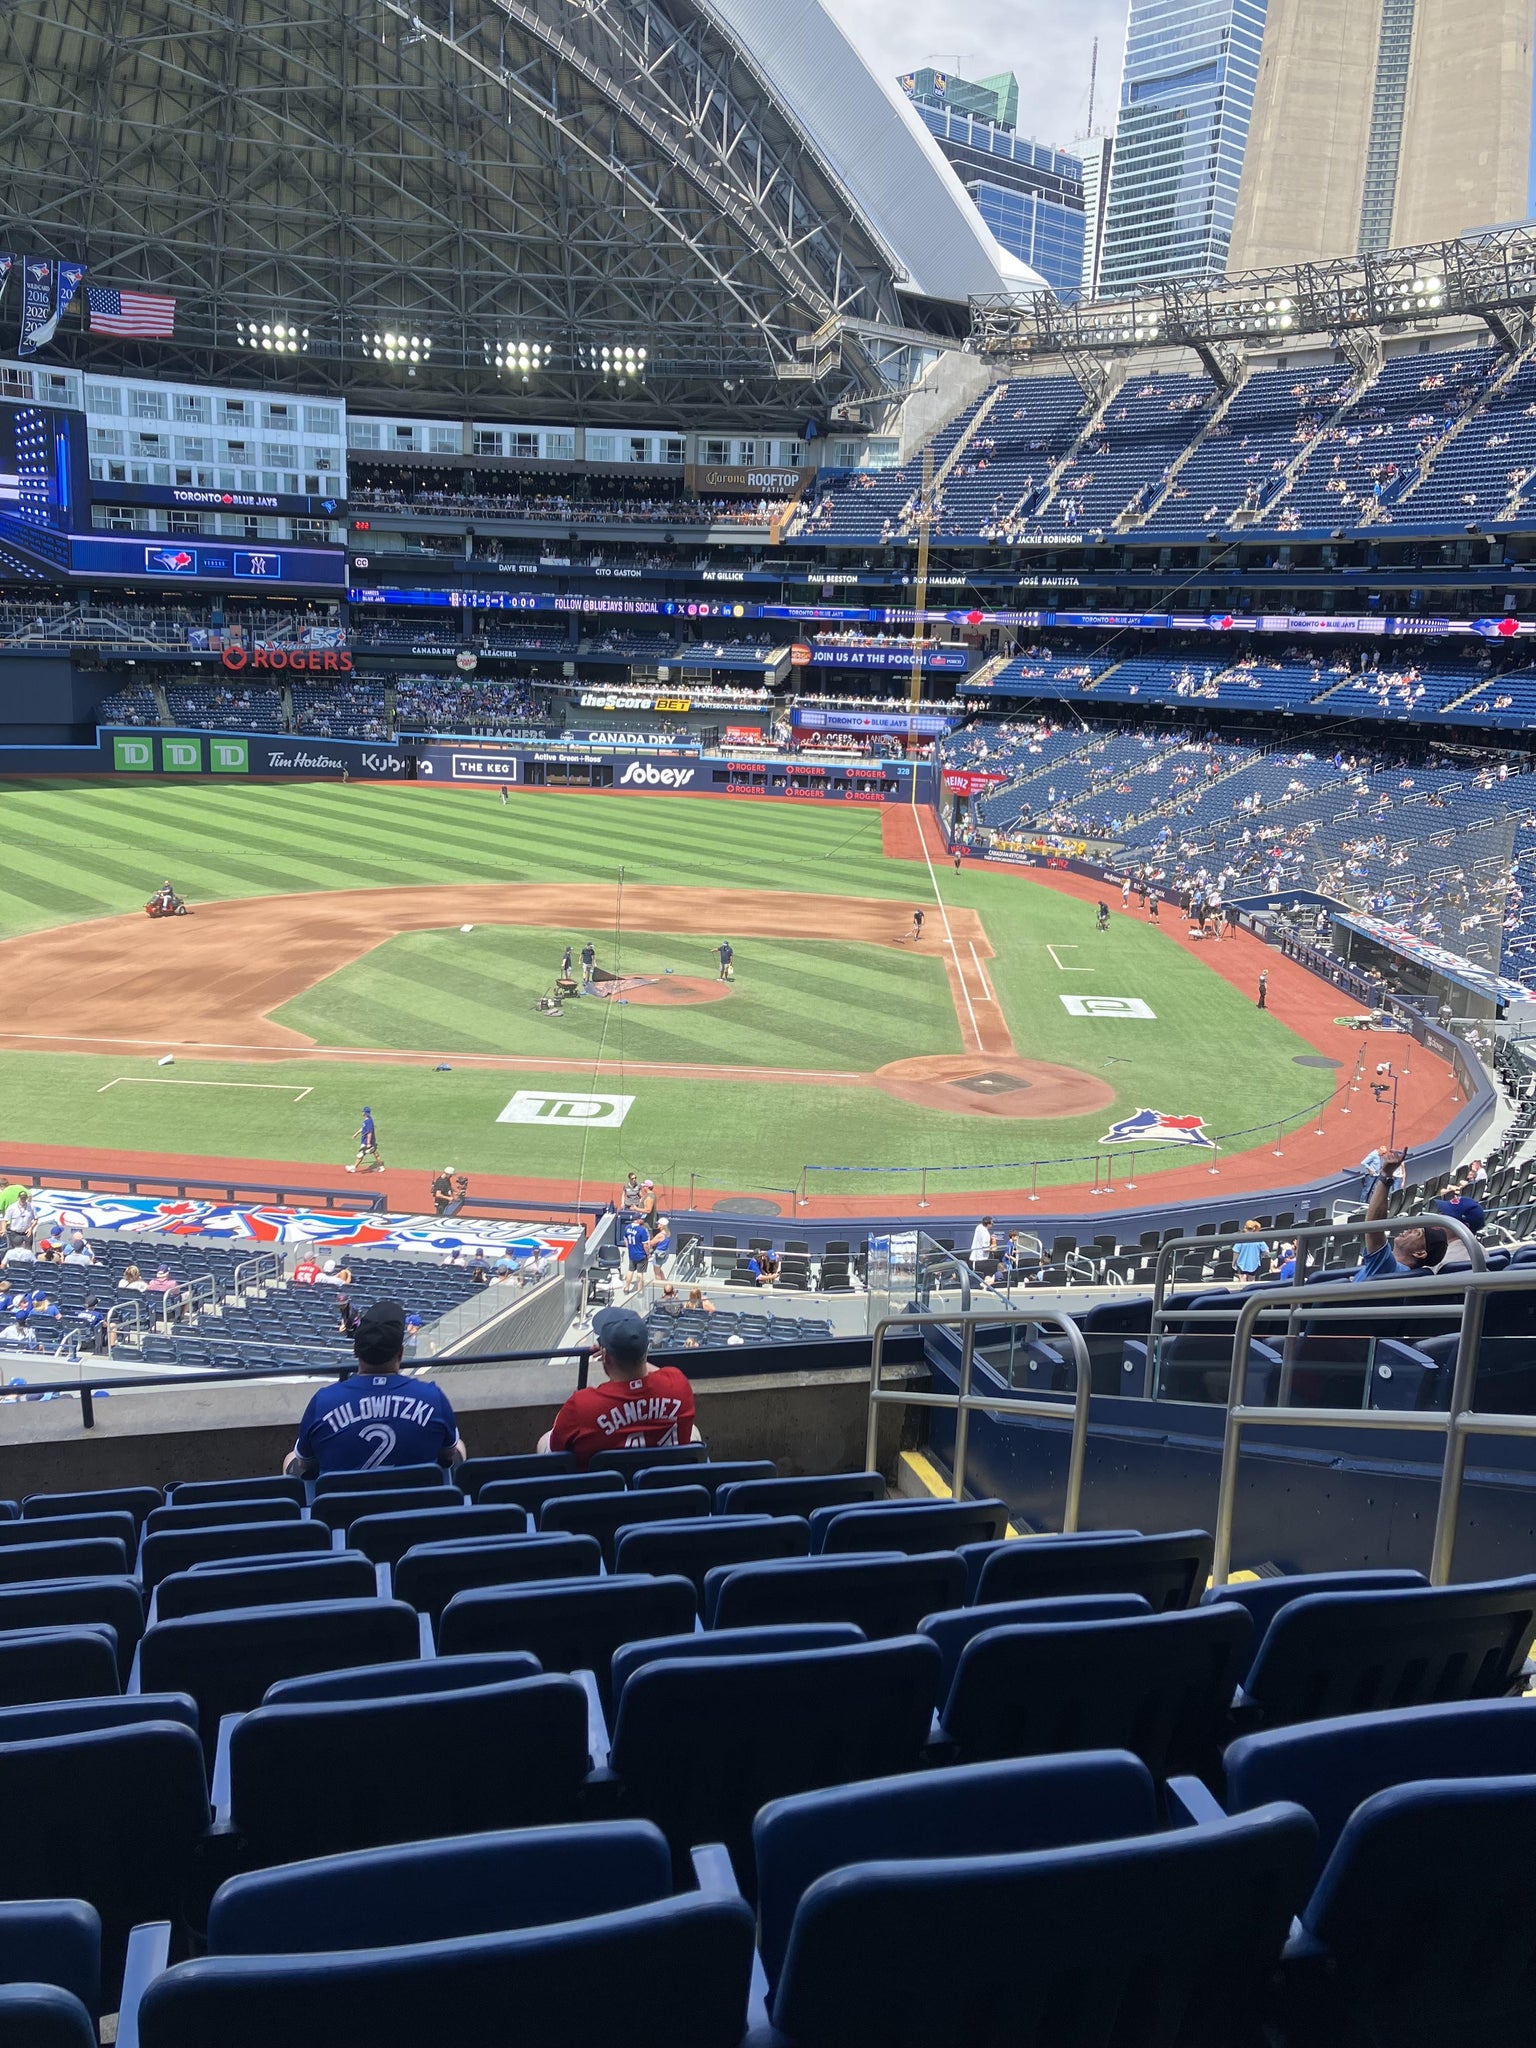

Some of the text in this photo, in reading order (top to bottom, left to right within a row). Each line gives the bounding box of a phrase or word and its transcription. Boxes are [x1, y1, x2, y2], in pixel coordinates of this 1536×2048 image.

[28, 290, 49, 304] 2016
[706, 472, 799, 486] Corona ROOFTOP
[174, 490, 278, 507] TORONTO BLUE JAYS
[1017, 536, 1042, 544] JACKIE
[1043, 535, 1082, 544] ROBINSON
[717, 572, 744, 580] GILLICK
[1019, 576, 1079, 586] JOSÉ BAUTISTA
[555, 598, 658, 613] FOLLOW @BLUEJAYS ON SOCIAL
[254, 650, 352, 670] ROGERS
[480, 650, 516, 658] BLEACHERS
[814, 652, 832, 661] JOIN
[836, 653, 848, 662] US
[851, 654, 864, 662] AT
[868, 654, 884, 663] THE
[888, 655, 926, 665] PORCH!
[580, 694, 651, 710] theScore
[657, 700, 689, 710] BET
[828, 716, 862, 725] TORONTO
[588, 732, 645, 744] CANADA
[648, 735, 676, 745] DRY
[118, 744, 148, 764] TD
[166, 744, 196, 764] TD
[214, 746, 244, 766] TD
[268, 752, 342, 768] Tim Hortons
[534, 752, 556, 760] Active
[362, 754, 433, 774] Kuba
[460, 762, 510, 773] THE KEG
[736, 763, 766, 772] ROGERS
[796, 766, 826, 774] ROGERS
[620, 761, 694, 788] Sobeys
[855, 770, 886, 778] ROGERS
[944, 776, 968, 789] HEINZ
[735, 786, 765, 794] ROGERS
[794, 788, 824, 797] ROGERS
[854, 792, 885, 800] ROGERS
[526, 1098, 614, 1118] TD
[322, 1394, 434, 1432] TULOWITZKI
[596, 1397, 682, 1436] SANCHEZ
[358, 1422, 396, 1472] 2
